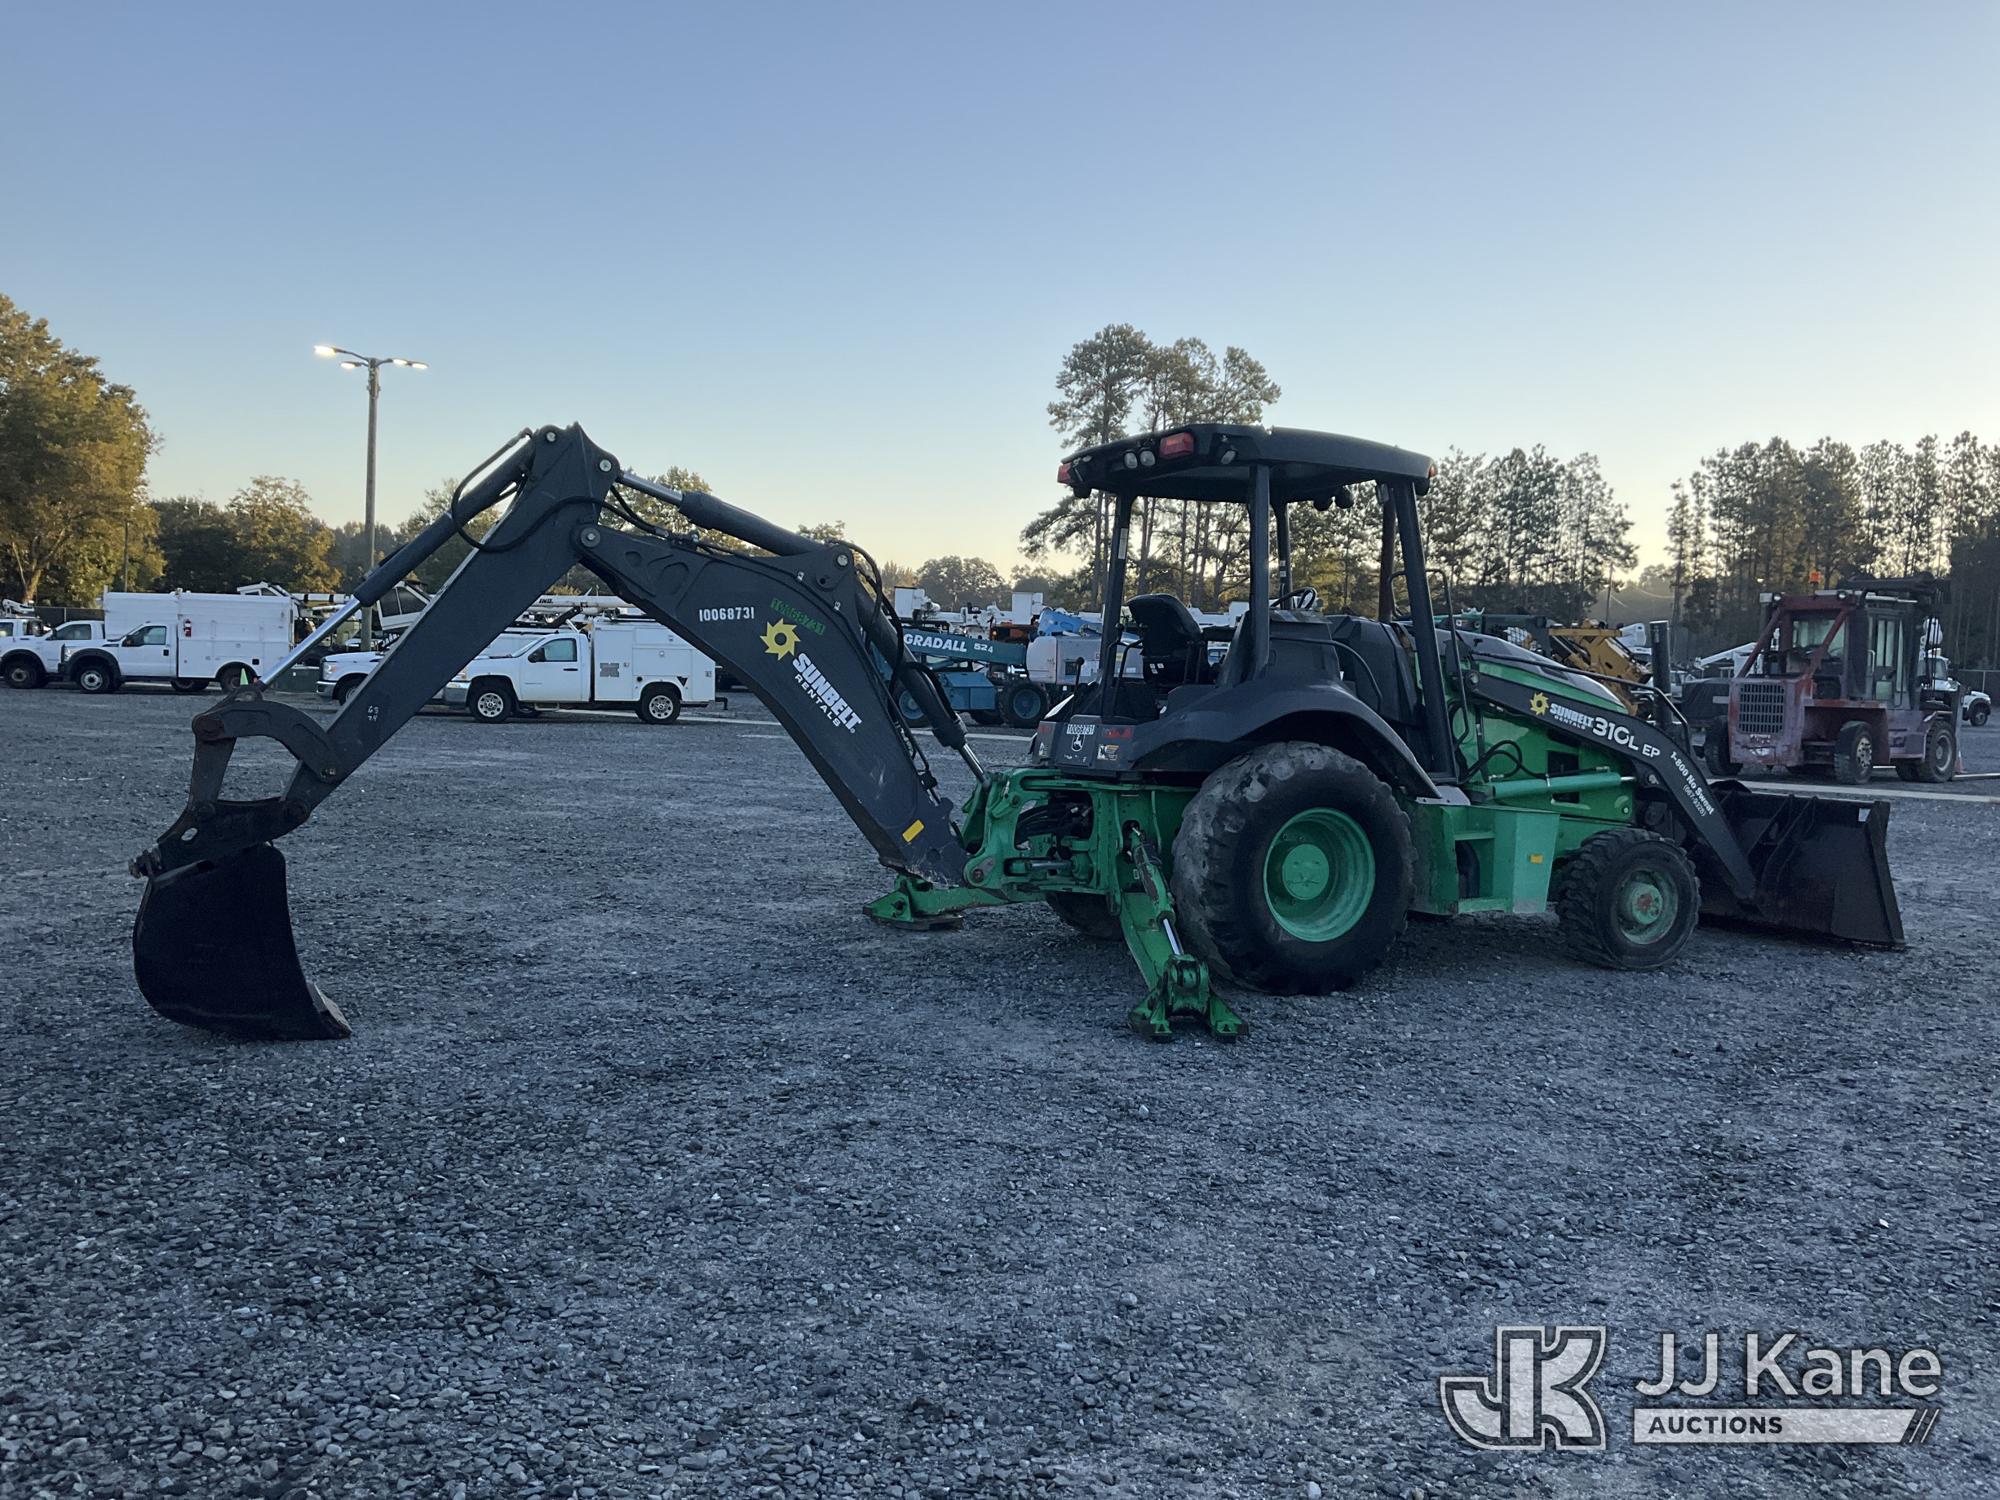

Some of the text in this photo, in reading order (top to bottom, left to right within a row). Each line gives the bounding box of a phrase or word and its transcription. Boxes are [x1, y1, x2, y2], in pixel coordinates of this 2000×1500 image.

[699, 606, 755, 622] 10068731
[904, 633, 967, 653] GRADALL
[792, 652, 862, 733] SUNBELT
[794, 675, 841, 727] RENTALS
[1549, 703, 1595, 728] SUNBELT
[1642, 743, 1661, 759] EP
[1669, 751, 1716, 815] 1-800 No Sweat
